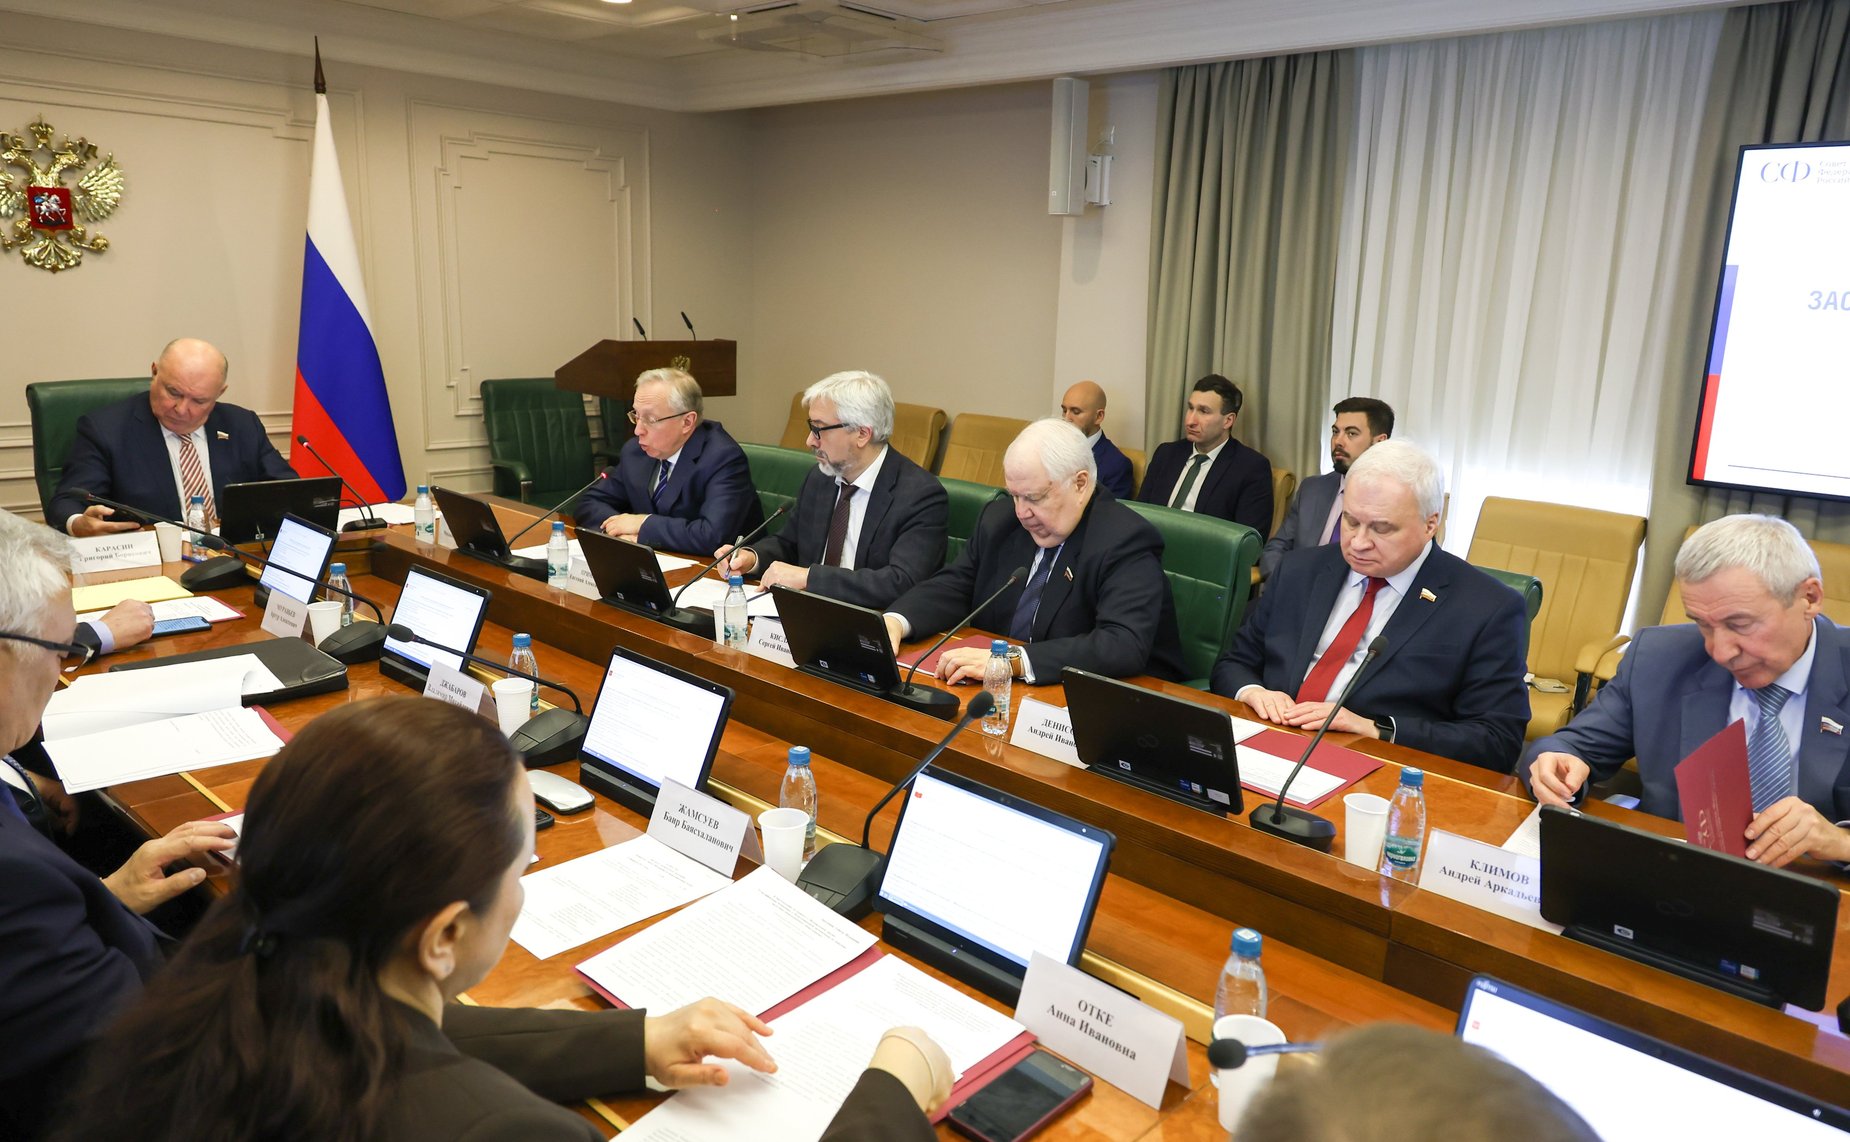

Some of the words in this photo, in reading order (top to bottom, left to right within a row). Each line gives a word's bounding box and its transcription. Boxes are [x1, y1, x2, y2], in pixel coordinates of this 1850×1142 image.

[1760, 160, 1811, 183] СФ
[95, 543, 134, 553] КАРАСИН
[758, 639, 776, 650] Сергей
[440, 679, 467, 698] ДЖАБАРОВ
[1027, 726, 1053, 741] Андрей
[678, 803, 720, 830] ЖАМСУЕВ
[663, 811, 681, 828] Баир
[681, 821, 734, 853] Баясхаланович
[1439, 865, 1481, 886] Андрей
[1470, 859, 1530, 885] КЛИМОВ
[1078, 999, 1115, 1027] ОТКЕ
[1046, 1004, 1076, 1027] Анна
[1079, 1019, 1137, 1061] Ивановна
